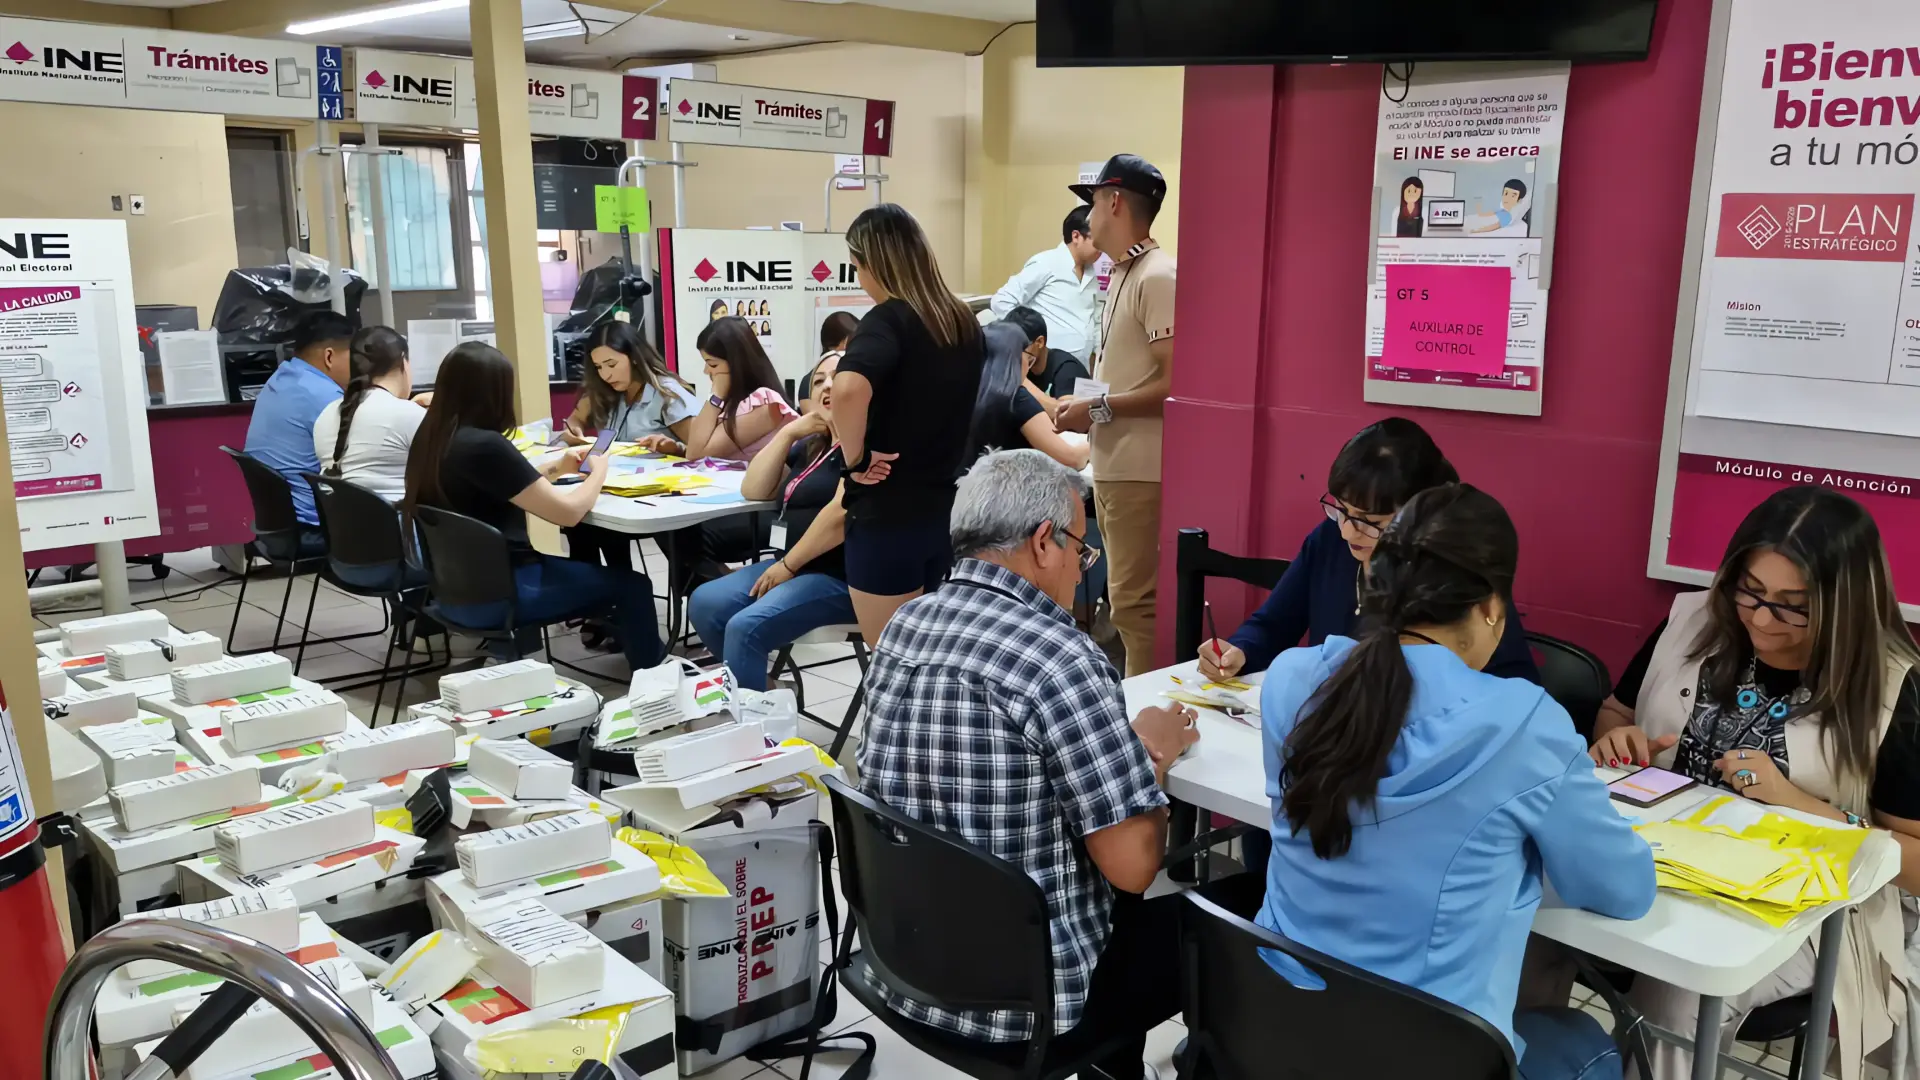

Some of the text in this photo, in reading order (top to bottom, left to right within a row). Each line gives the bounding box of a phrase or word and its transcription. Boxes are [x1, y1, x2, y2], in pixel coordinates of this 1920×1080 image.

[44, 47, 123, 74] INE
[147, 45, 269, 75] Trámites
[394, 74, 452, 98] INE
[528, 79, 565, 98] ites
[632, 96, 650, 121] 2
[697, 102, 741, 121] INE
[754, 99, 823, 120] Trámites
[874, 118, 885, 139] 1
[1393, 145, 1540, 161] El INE se acerca
[1770, 143, 1792, 166] a
[1806, 136, 1841, 166] tu
[1795, 204, 1901, 236] PLAN
[1793, 236, 1897, 251] ESTRATÉGICO
[20, 263, 73, 272] Electoral
[726, 260, 792, 283] INE
[4, 290, 73, 311] LA CALIDAD
[1397, 288, 1429, 301] GT 5
[1409, 321, 1484, 336] AUXILIAR DE
[1415, 341, 1475, 356] CONTROL
[1716, 460, 1912, 495] Módulo de Atención
[736, 857, 748, 898] SOBRE
[737, 899, 748, 915] EL
[751, 886, 775, 981] PREP
